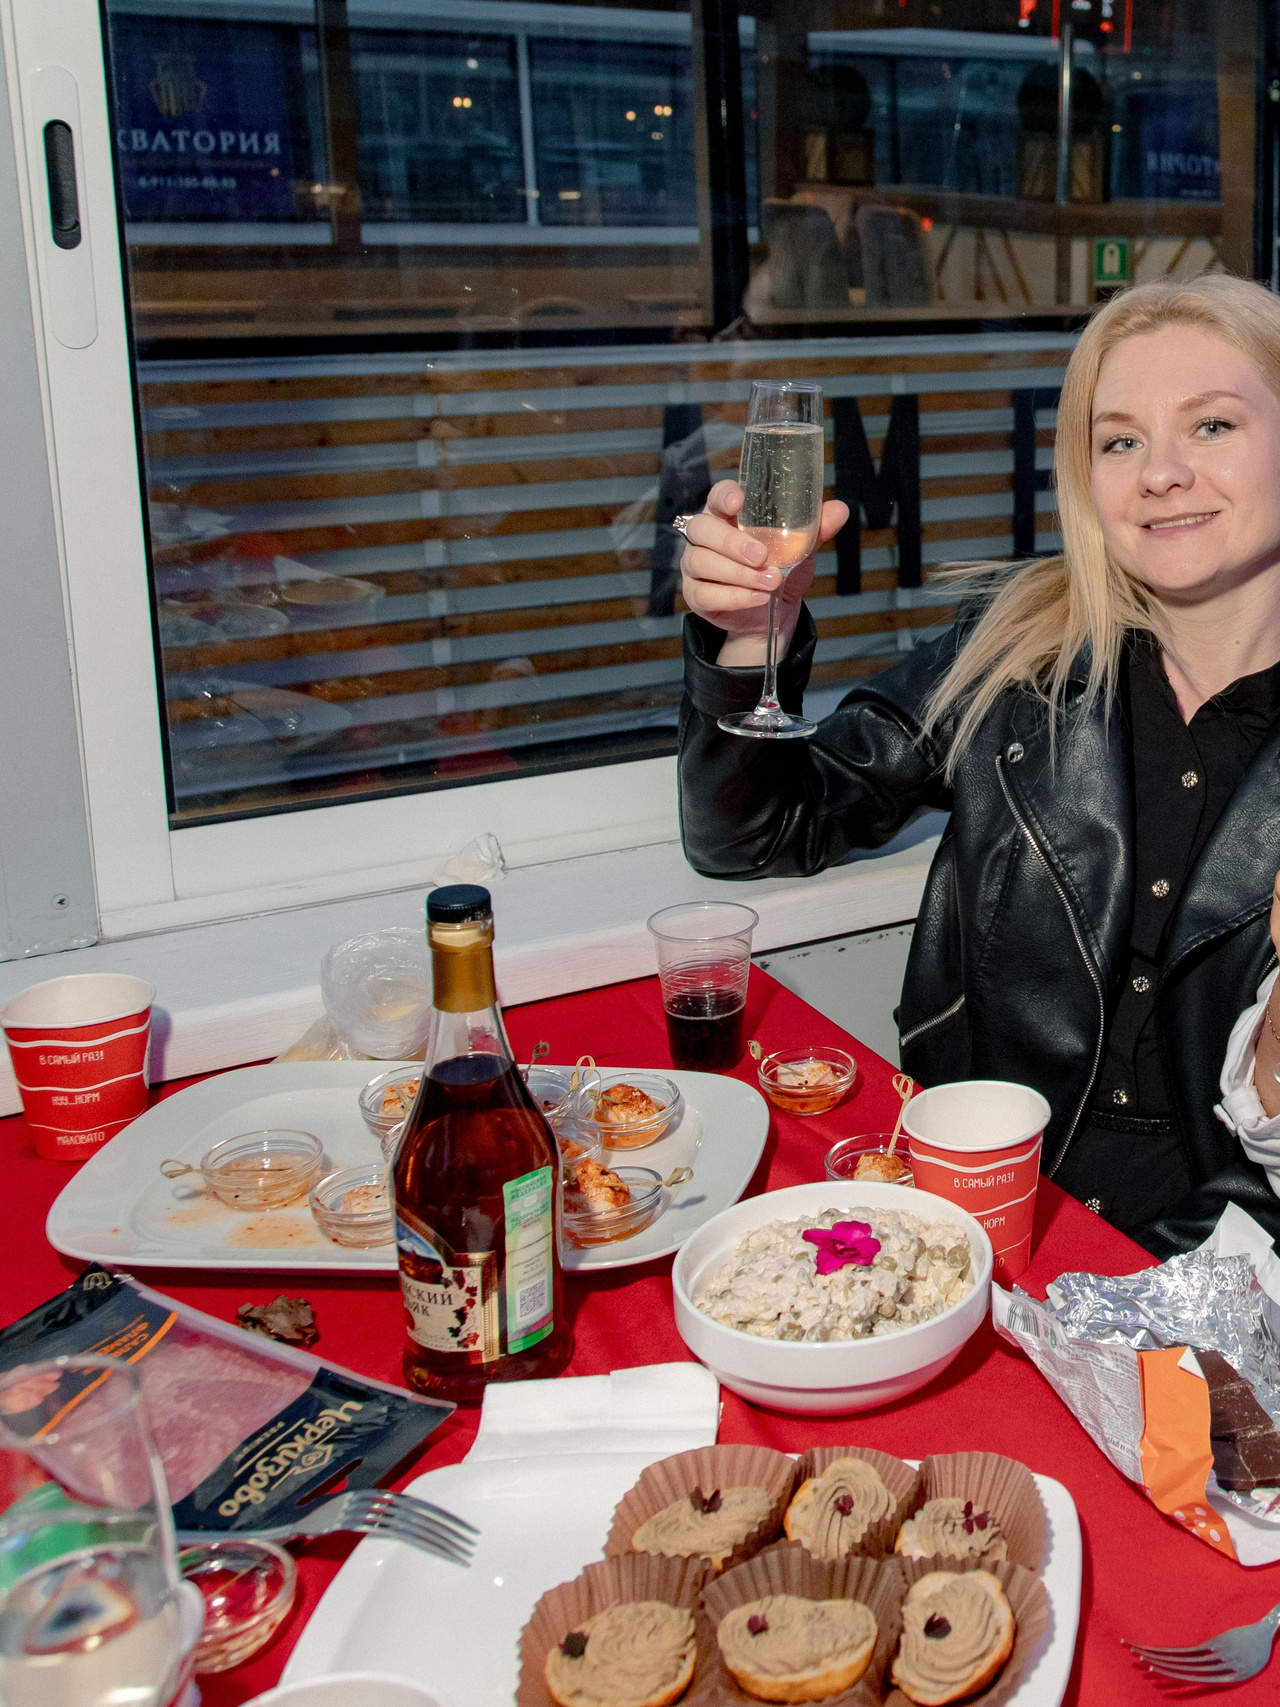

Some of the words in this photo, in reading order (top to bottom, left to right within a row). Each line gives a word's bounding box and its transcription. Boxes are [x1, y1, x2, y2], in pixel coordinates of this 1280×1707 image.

[39, 1055, 46, 1065] В
[48, 1053, 80, 1065] САМЫЙ
[82, 1050, 104, 1062] РАЗ!
[56, 1131, 105, 1145] МАЛОВАТО
[953, 1178, 960, 1188] В
[962, 1175, 994, 1189] САМЫЙ
[996, 1172, 1014, 1185] РАЗ!
[234, 1421, 285, 1462] PREMIUM
[218, 1401, 363, 1517] Черкизово
